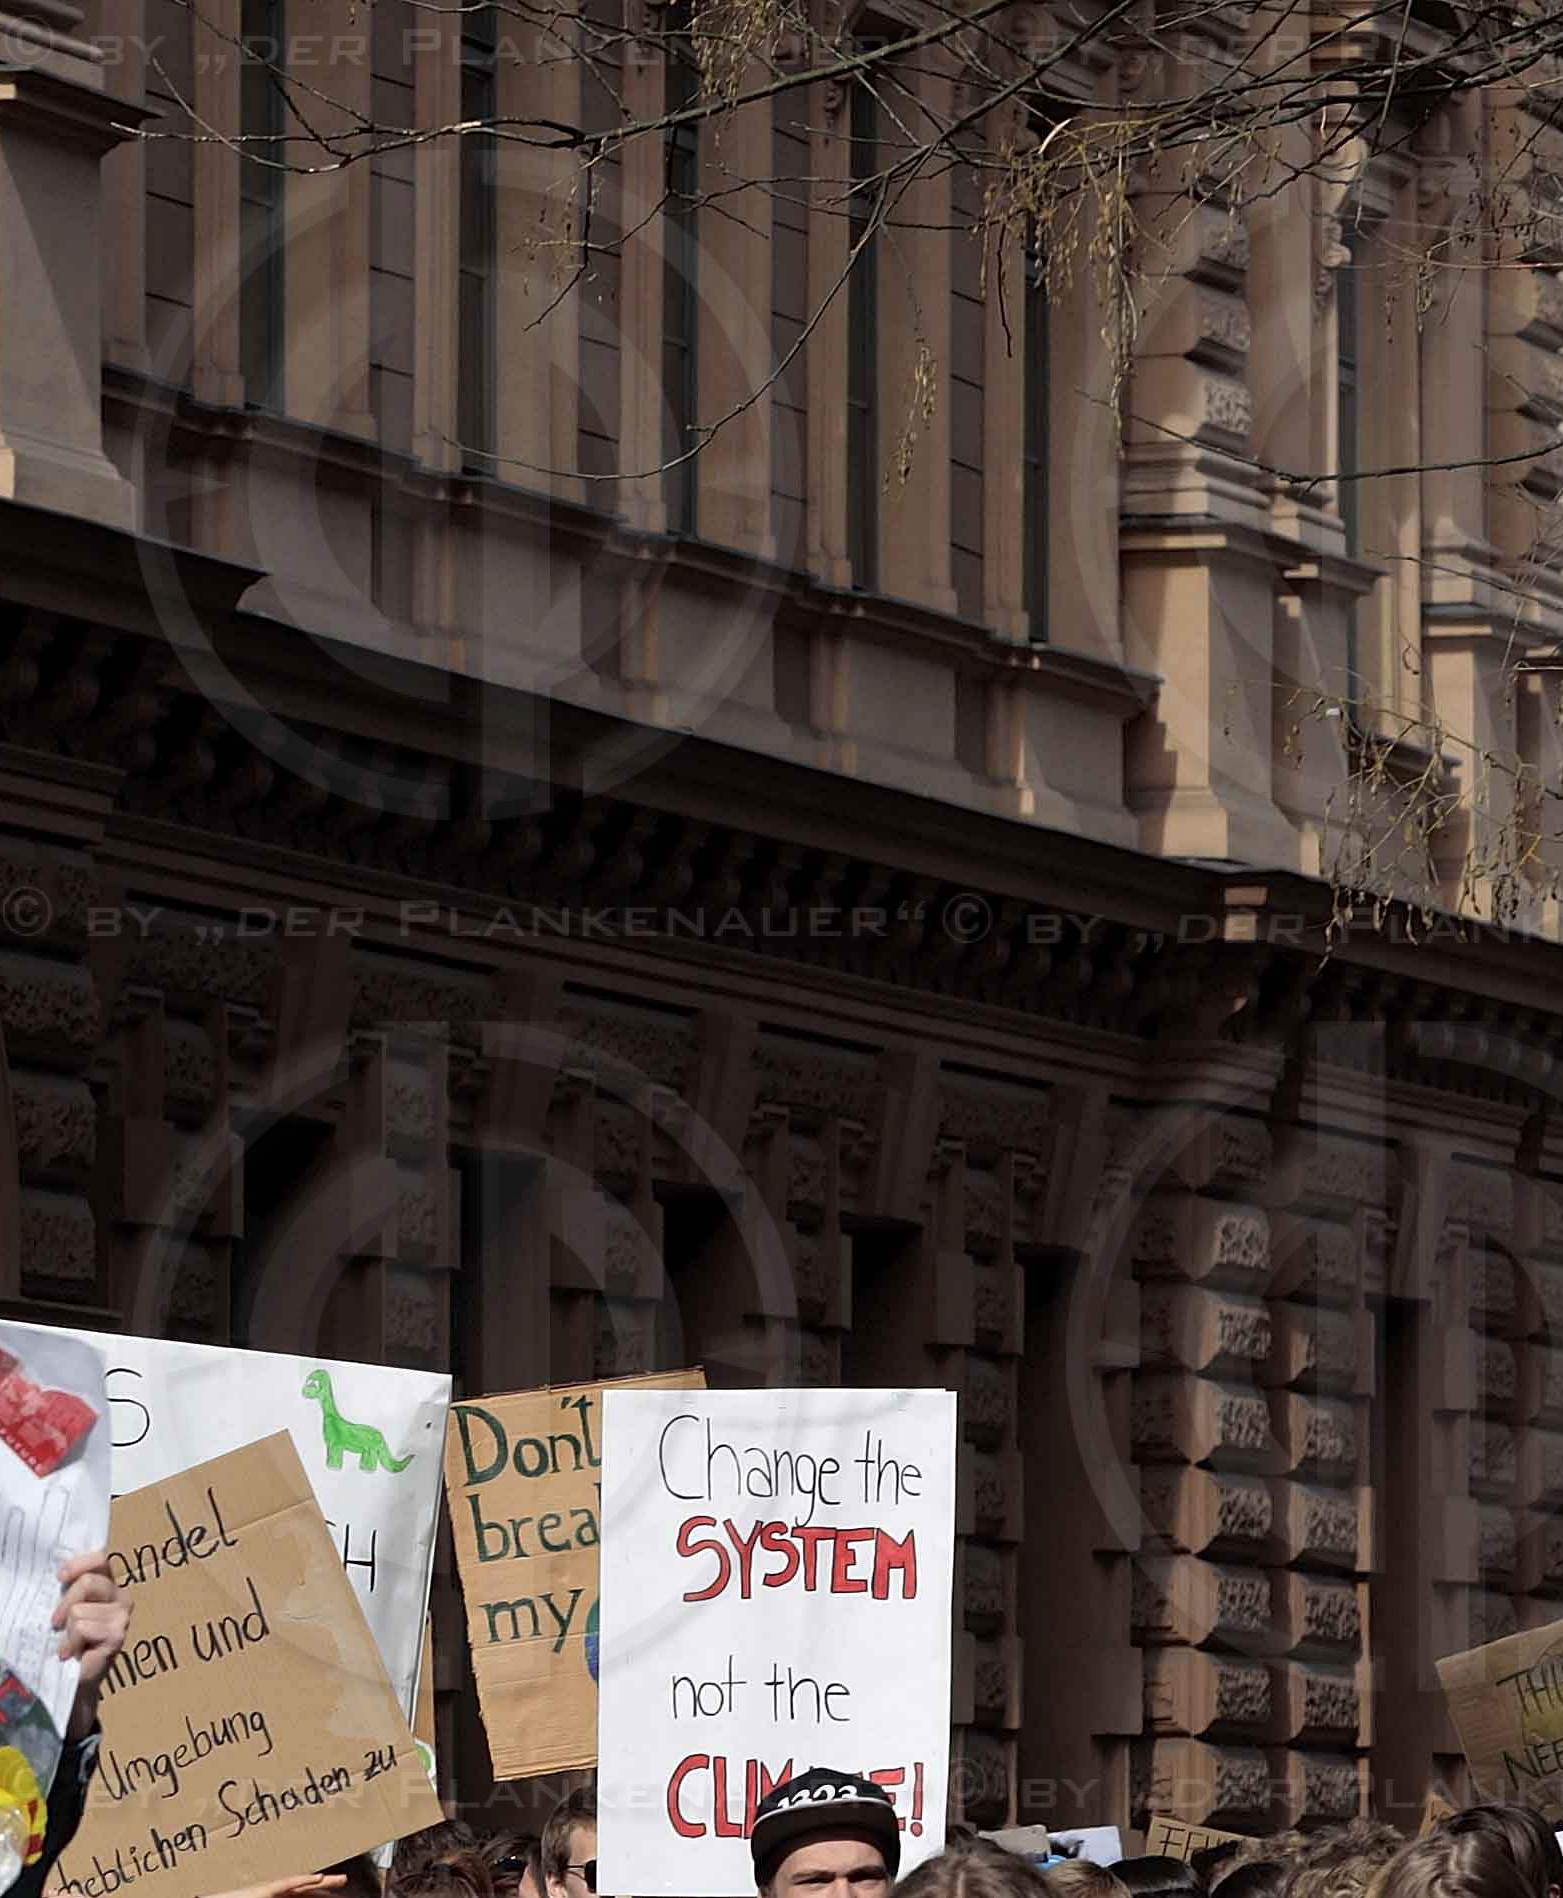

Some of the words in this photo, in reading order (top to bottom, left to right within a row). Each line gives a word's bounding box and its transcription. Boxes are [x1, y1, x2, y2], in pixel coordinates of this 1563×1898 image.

[448, 1393, 601, 1486] Don't
[658, 1414, 842, 1526] Change
[855, 1428, 924, 1507] the
[467, 1482, 602, 1563] brea
[676, 1515, 919, 1602] SYSTEM
[193, 1577, 270, 1661] und
[476, 1587, 584, 1654] my
[669, 1654, 747, 1723] not
[763, 1656, 851, 1724] the
[95, 1705, 273, 1802] Umgebung
[217, 1763, 352, 1840] Schaden
[363, 1744, 398, 1782] zu
